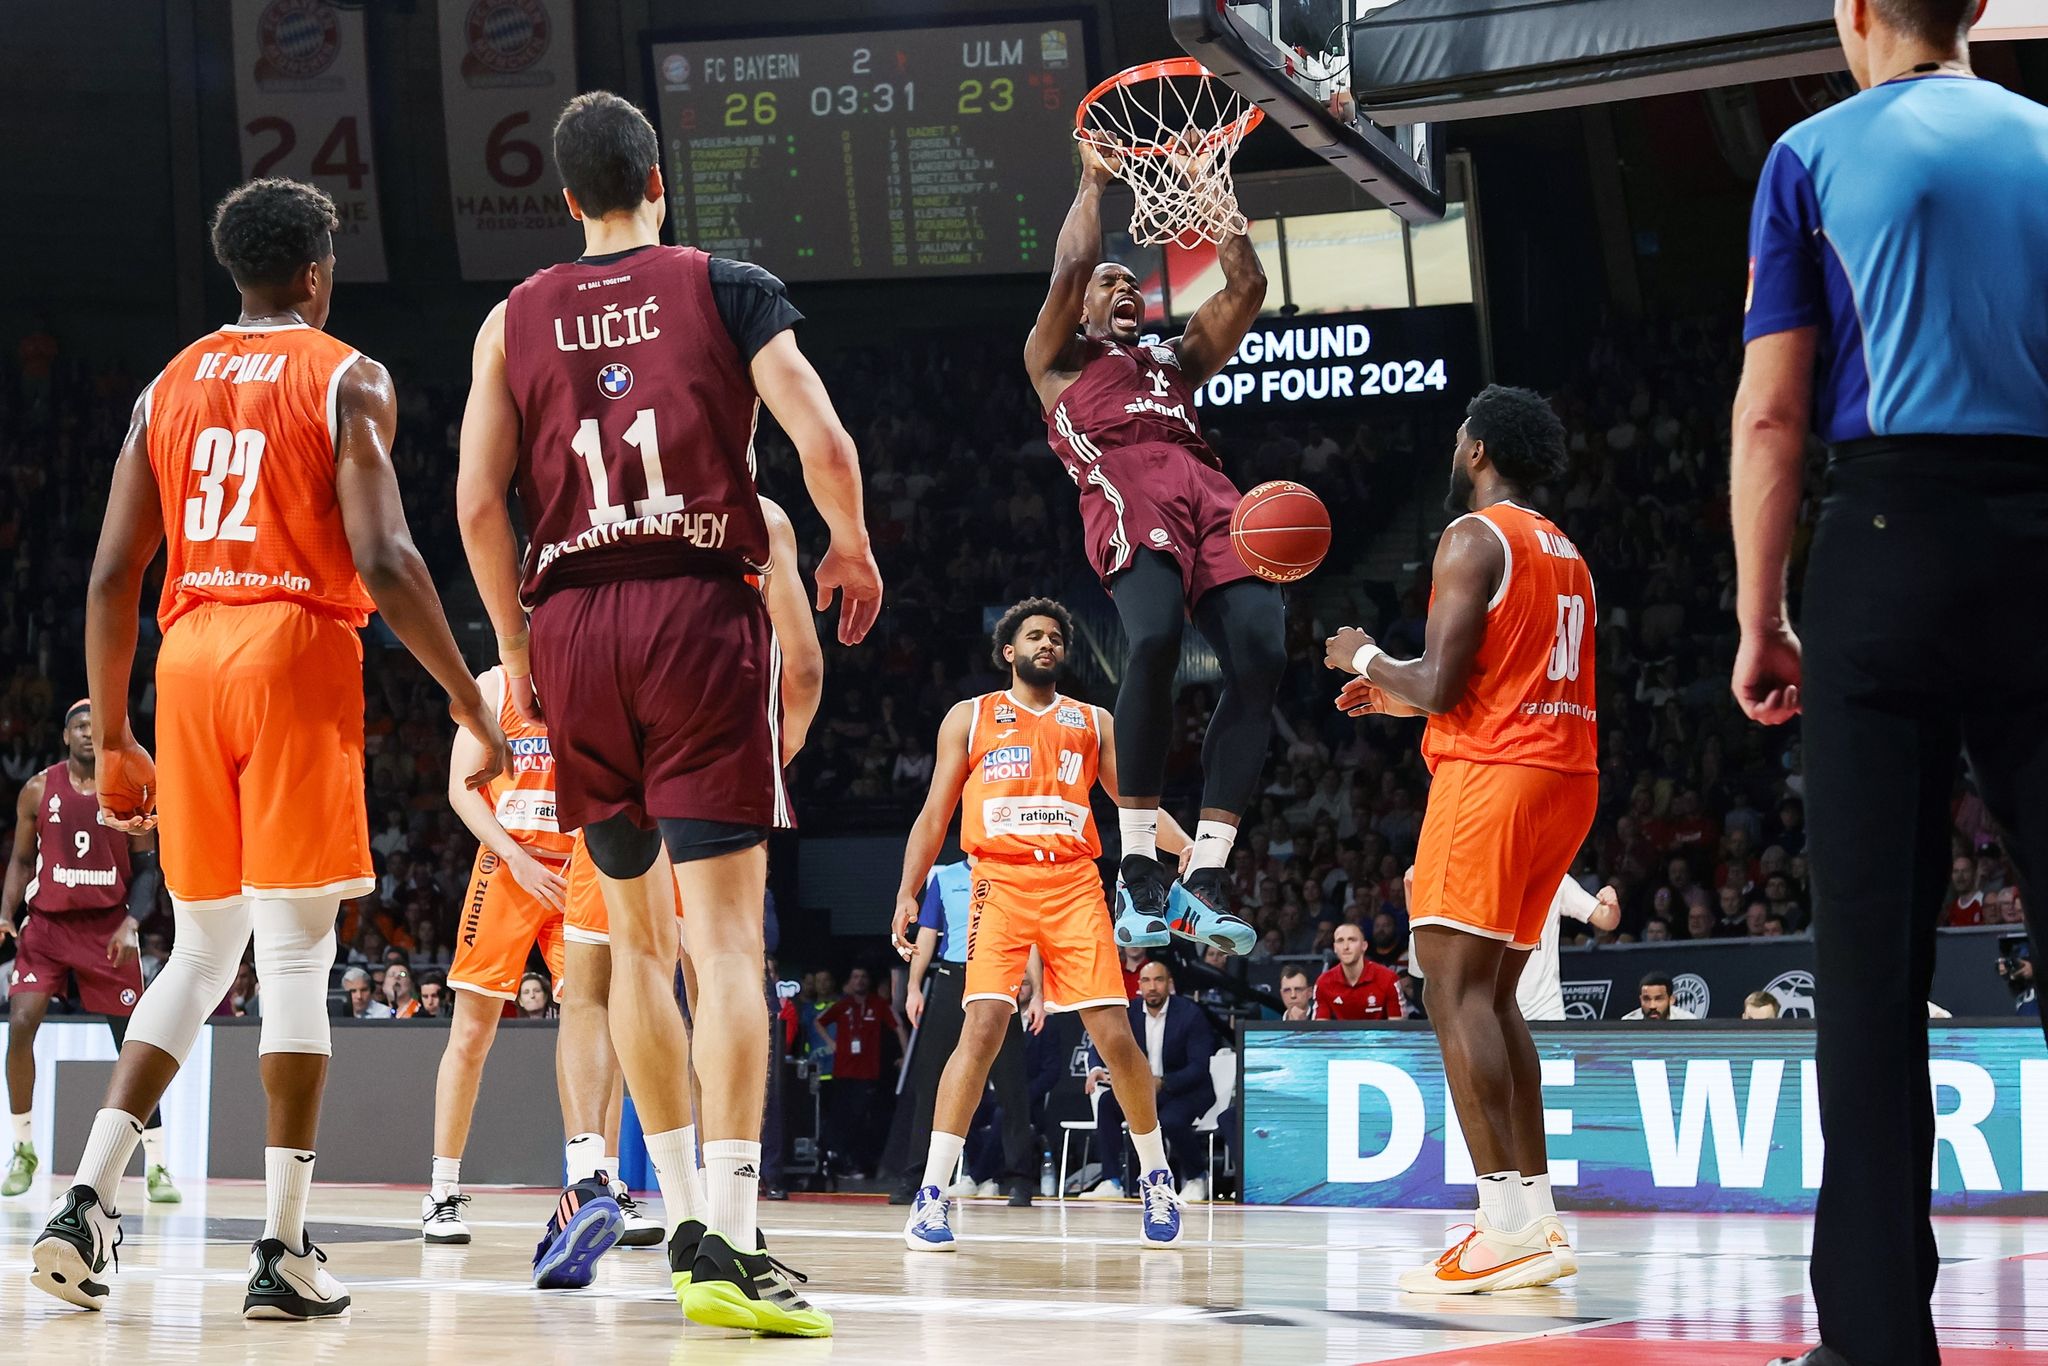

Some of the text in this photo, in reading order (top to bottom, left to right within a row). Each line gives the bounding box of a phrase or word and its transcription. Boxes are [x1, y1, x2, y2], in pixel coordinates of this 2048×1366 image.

[704, 53, 800, 83] FC BAYERN
[852, 48, 871, 74] 2
[962, 38, 1023, 67] ULM
[724, 91, 777, 126] 26
[811, 81, 915, 117] 03:31
[958, 77, 1014, 115] 23
[246, 116, 369, 190] 24
[486, 111, 544, 187] 6
[457, 194, 562, 216] HAMAN
[577, 283, 588, 291] WE
[603, 275, 631, 286] TOGETHER
[554, 296, 661, 352] LUČIĆ
[1226, 324, 1370, 366] GMUND
[194, 353, 227, 382] DE
[601, 365, 628, 377] BMW
[1262, 365, 1354, 402] FOUR
[1359, 358, 1447, 396] 2024
[184, 427, 266, 542] 32
[571, 408, 685, 527] 11
[1255, 565, 1306, 581] SPALD
[1547, 594, 1585, 682] 50
[984, 747, 1029, 767] LIQUI
[985, 763, 1030, 783] MOLY
[1057, 749, 1083, 786] 30
[991, 806, 1011, 823] 50
[74, 830, 91, 859] 9
[463, 879, 489, 948] Allianz
[1632, 1059, 2048, 1192] WR
